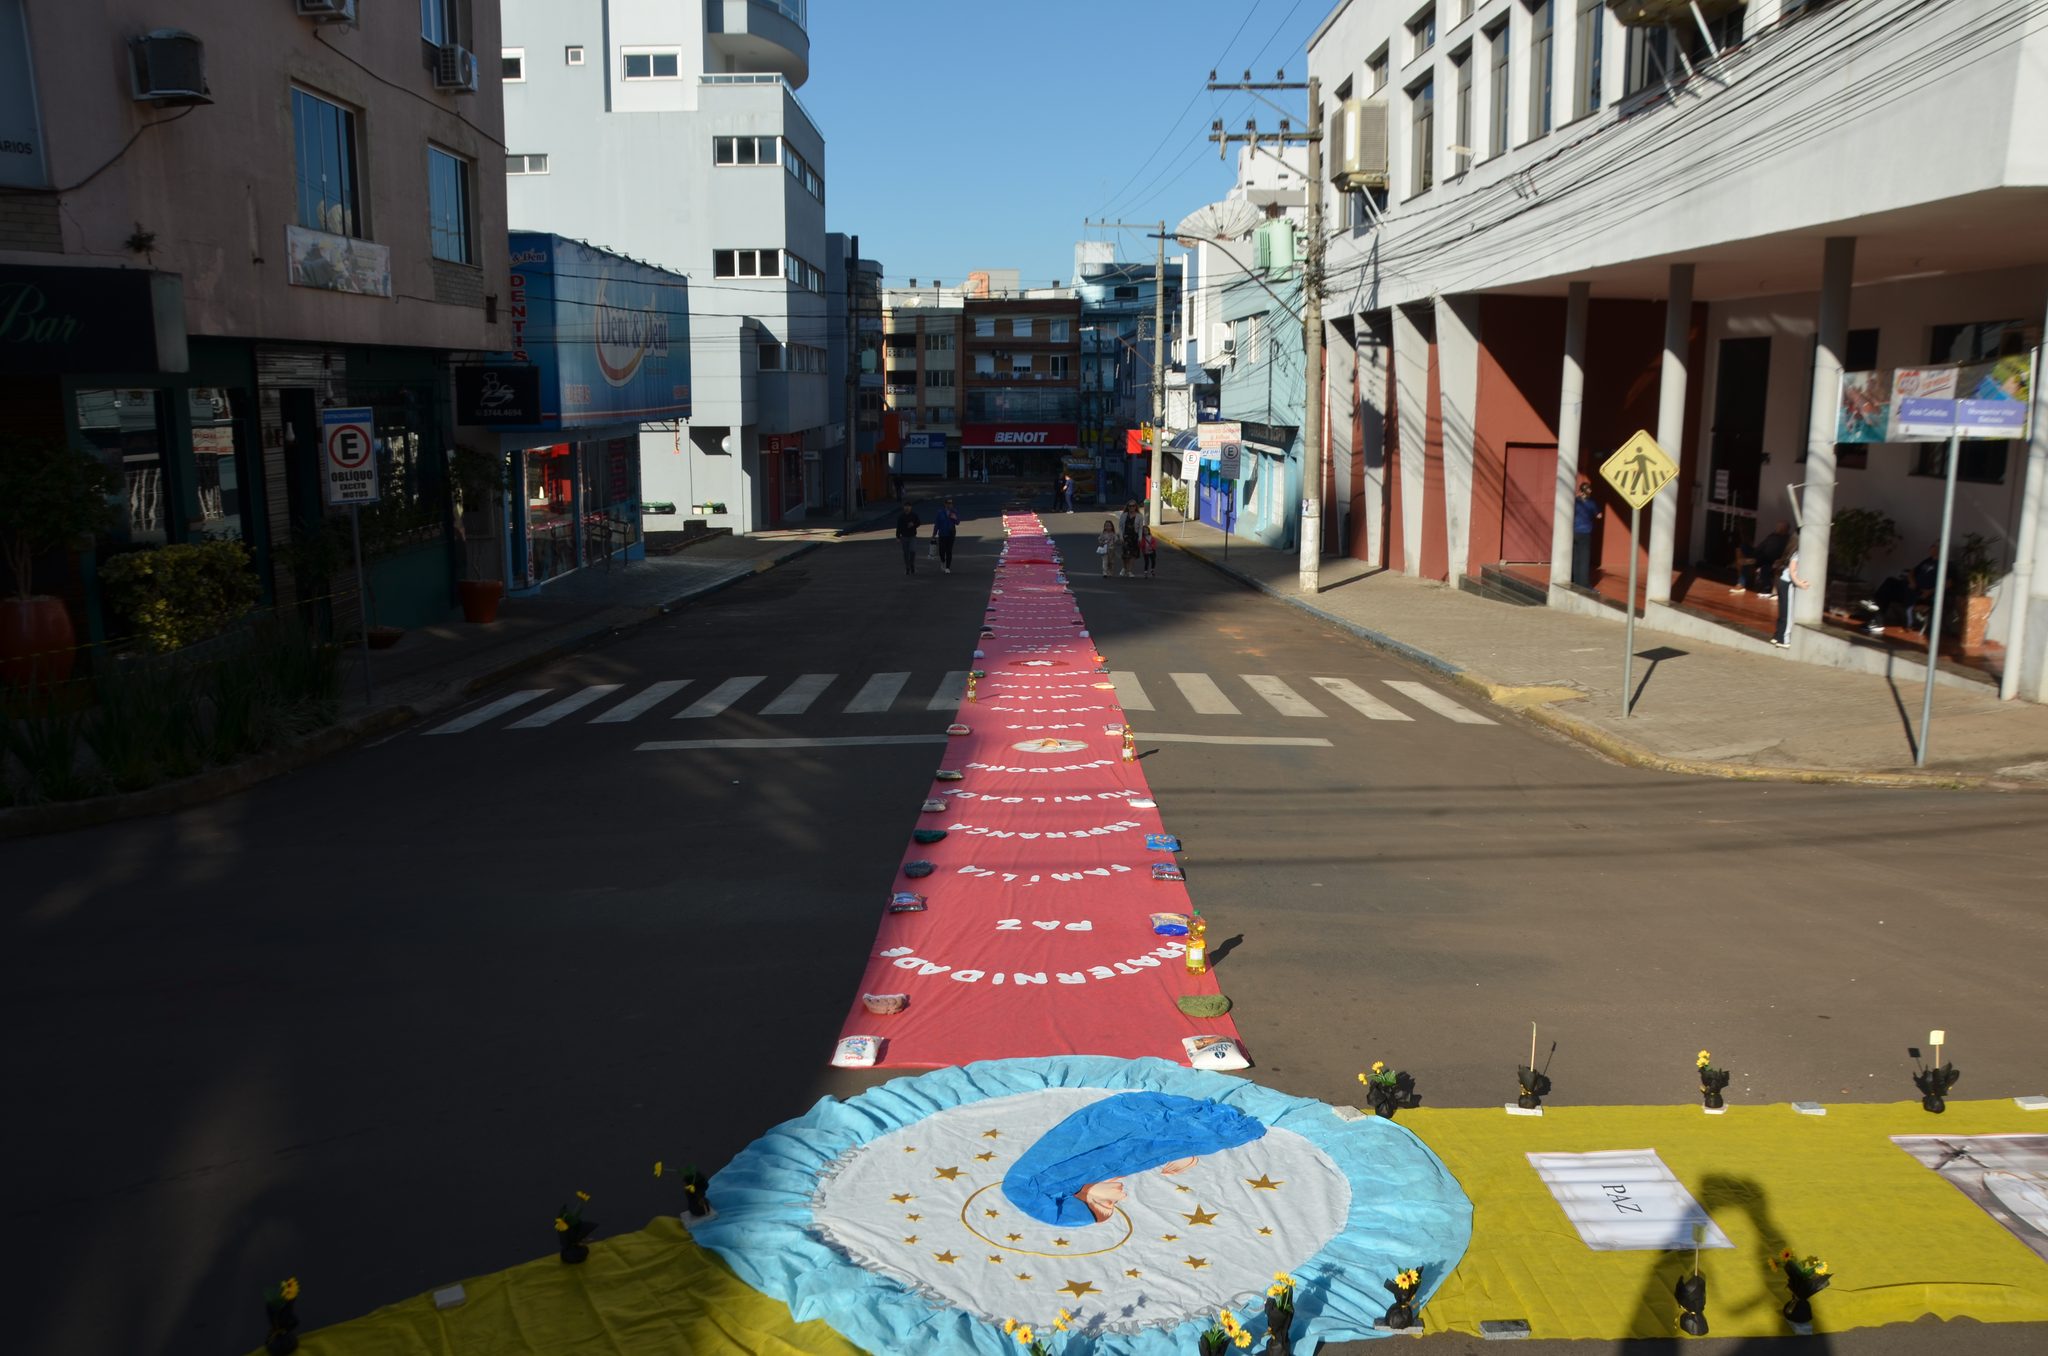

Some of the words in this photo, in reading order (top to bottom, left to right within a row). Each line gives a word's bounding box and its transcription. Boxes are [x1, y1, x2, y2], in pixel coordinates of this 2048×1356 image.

[600, 303, 629, 348] Dent
[632, 313, 641, 349] &
[644, 312, 669, 352] Dent
[341, 434, 359, 460] E
[994, 432, 1048, 443] BENOIT
[1188, 454, 1193, 462] E
[1228, 447, 1234, 456] E
[942, 788, 1141, 803] HUMILDADE
[947, 820, 1141, 839] ESPERANÇA
[957, 863, 1132, 887] FAMÍLIA
[995, 918, 1093, 931] PAZ
[880, 941, 1187, 986] FRATERNIDADE
[1601, 1184, 1643, 1214] PAZ
